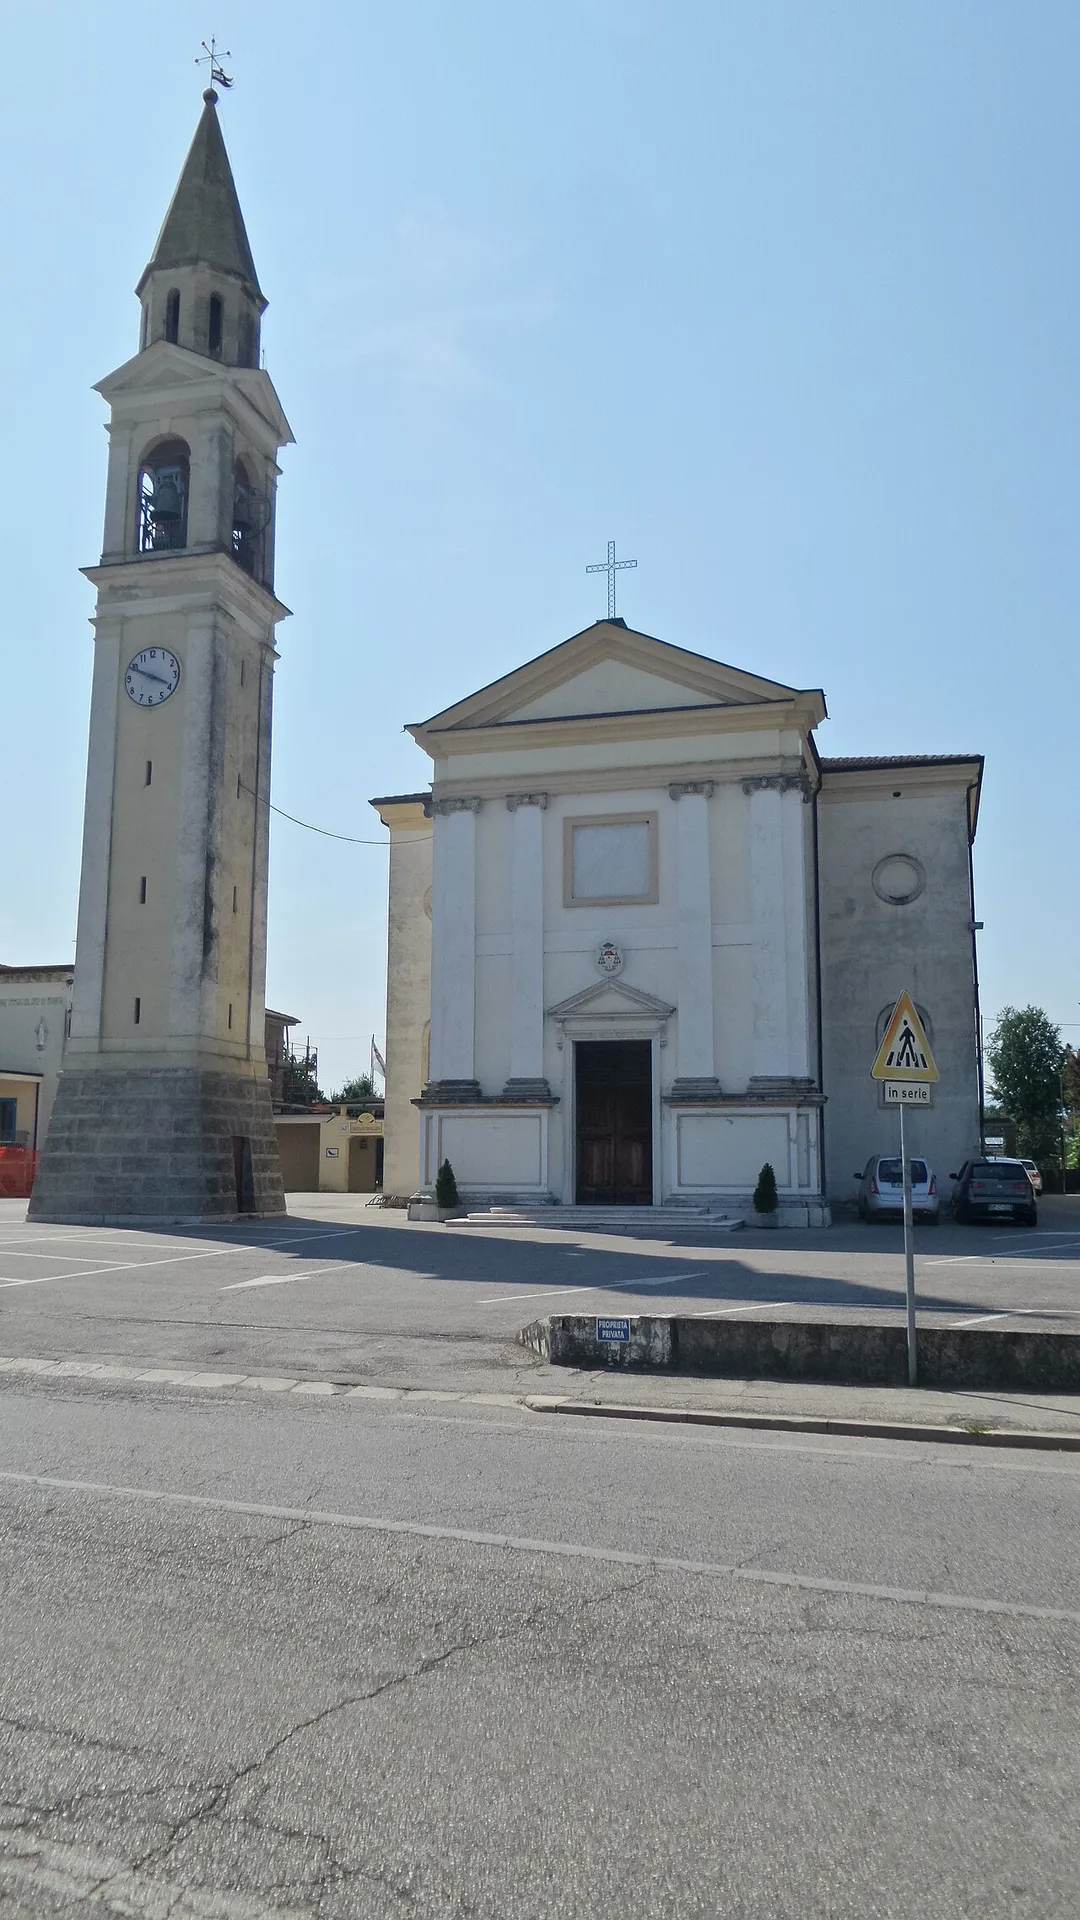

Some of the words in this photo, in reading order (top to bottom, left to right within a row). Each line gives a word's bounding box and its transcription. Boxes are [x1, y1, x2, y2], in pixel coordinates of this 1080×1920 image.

[140, 654, 146, 662] 11
[150, 650, 156, 658] 12
[170, 659, 174, 667] 2
[139, 694, 144, 702] 7
[888, 1087, 898, 1098] in
[902, 1088, 927, 1099] serie
[602, 1330, 624, 1338] PRIVATA
